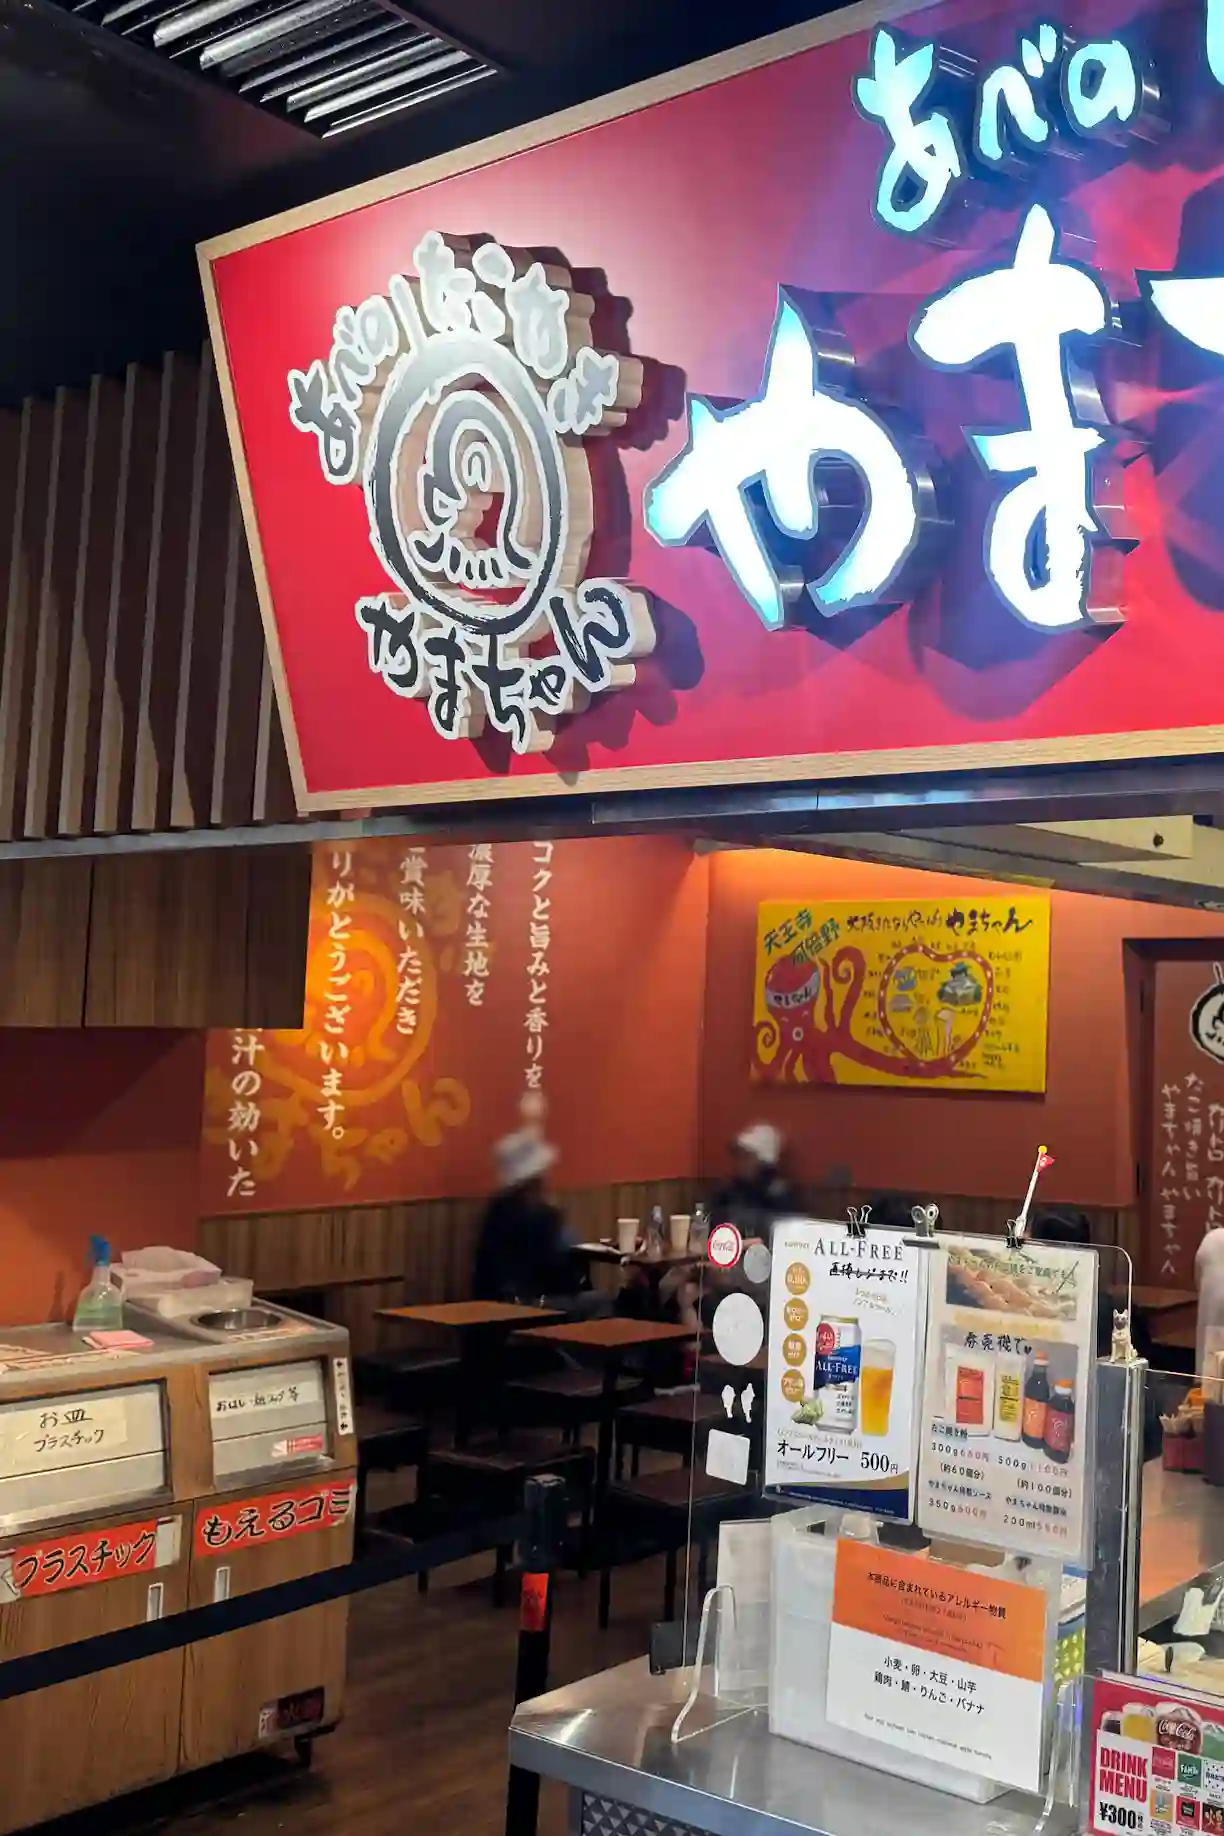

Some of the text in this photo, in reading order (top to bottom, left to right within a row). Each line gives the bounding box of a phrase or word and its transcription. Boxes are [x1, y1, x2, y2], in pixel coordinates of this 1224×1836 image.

[357, 581, 632, 752] やまちゃん
[395, 847, 428, 1034] 賞味いただき
[523, 841, 554, 1112] コクと旨みと香りを
[227, 1028, 265, 1197] 汁の効いた
[777, 1439, 849, 1465] オールフリー
[1099, 1769, 1147, 1803] MENU
[1100, 1747, 1148, 1778] DRINK
